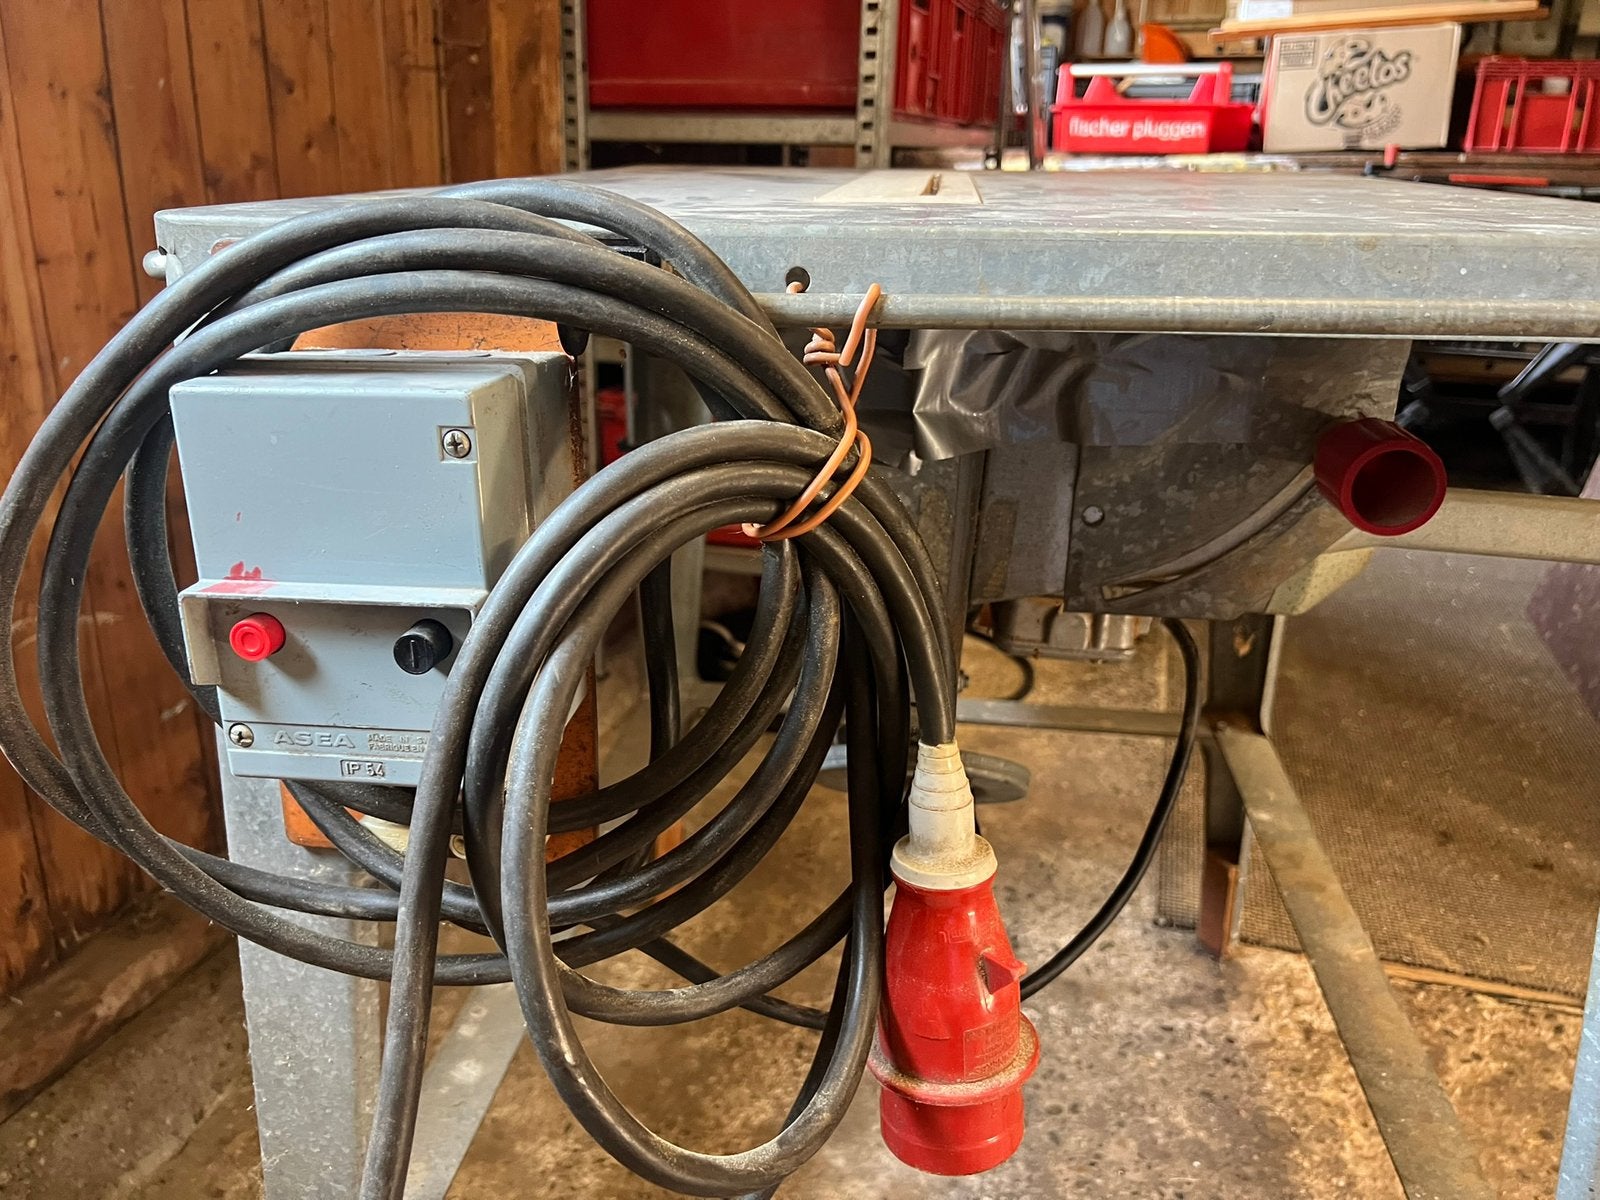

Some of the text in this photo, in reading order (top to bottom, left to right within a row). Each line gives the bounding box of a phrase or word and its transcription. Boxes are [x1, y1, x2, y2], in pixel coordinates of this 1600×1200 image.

[1304, 49, 1412, 125] Cheetos
[1069, 115, 1206, 141] fischer pluggen
[273, 730, 356, 748] ASEA
[344, 761, 385, 777] IP 54
